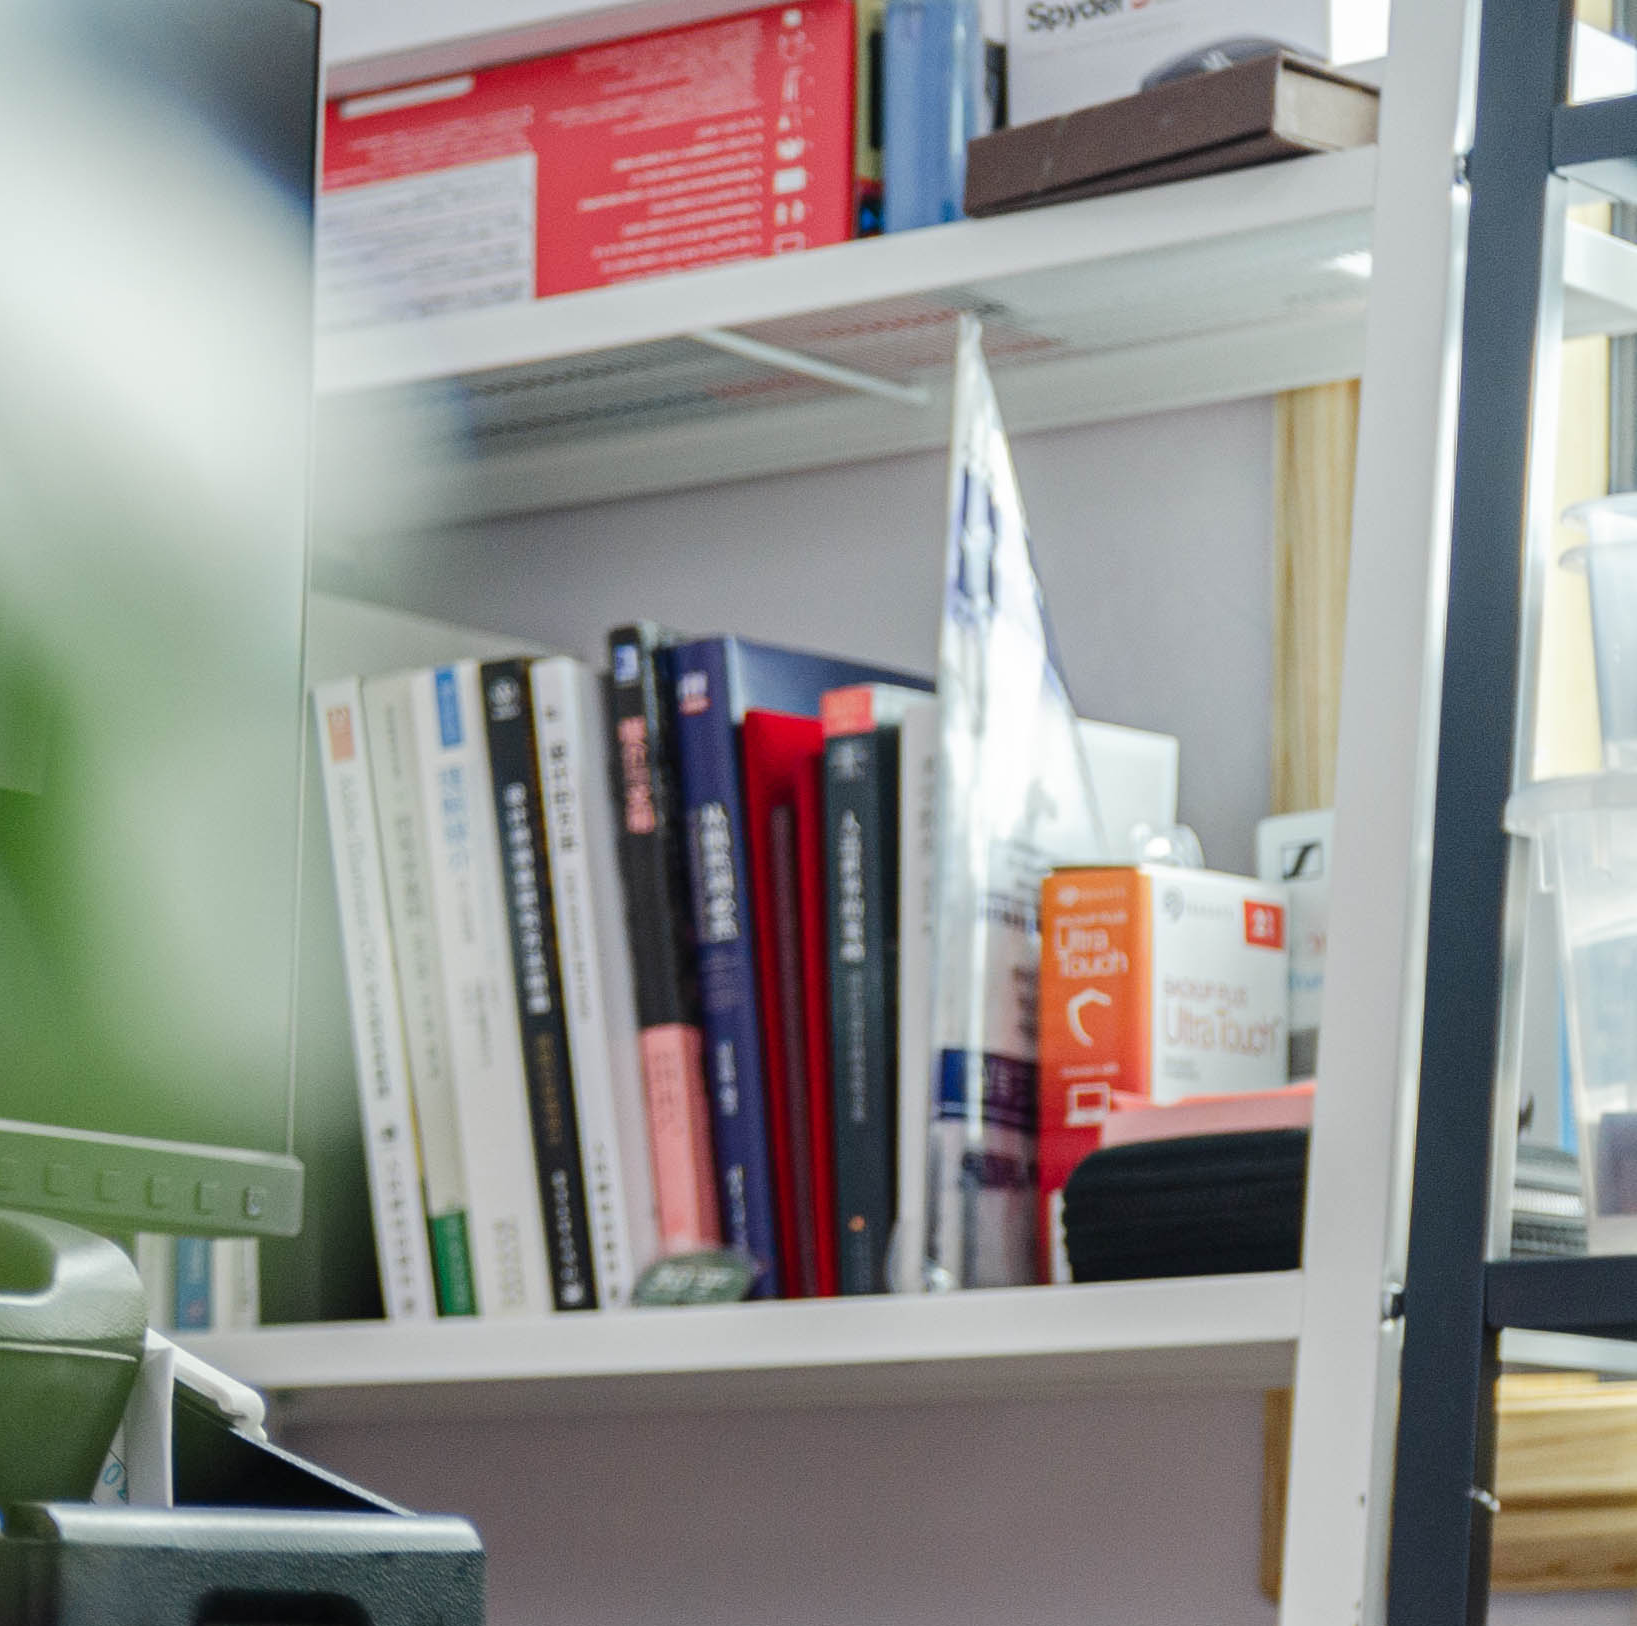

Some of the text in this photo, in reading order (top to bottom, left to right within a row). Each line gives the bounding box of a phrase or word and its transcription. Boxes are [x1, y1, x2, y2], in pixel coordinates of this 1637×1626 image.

[1026, 0, 1121, 32] Spyder
[1054, 926, 1109, 952] Ultra
[1057, 951, 1129, 978] Touch
